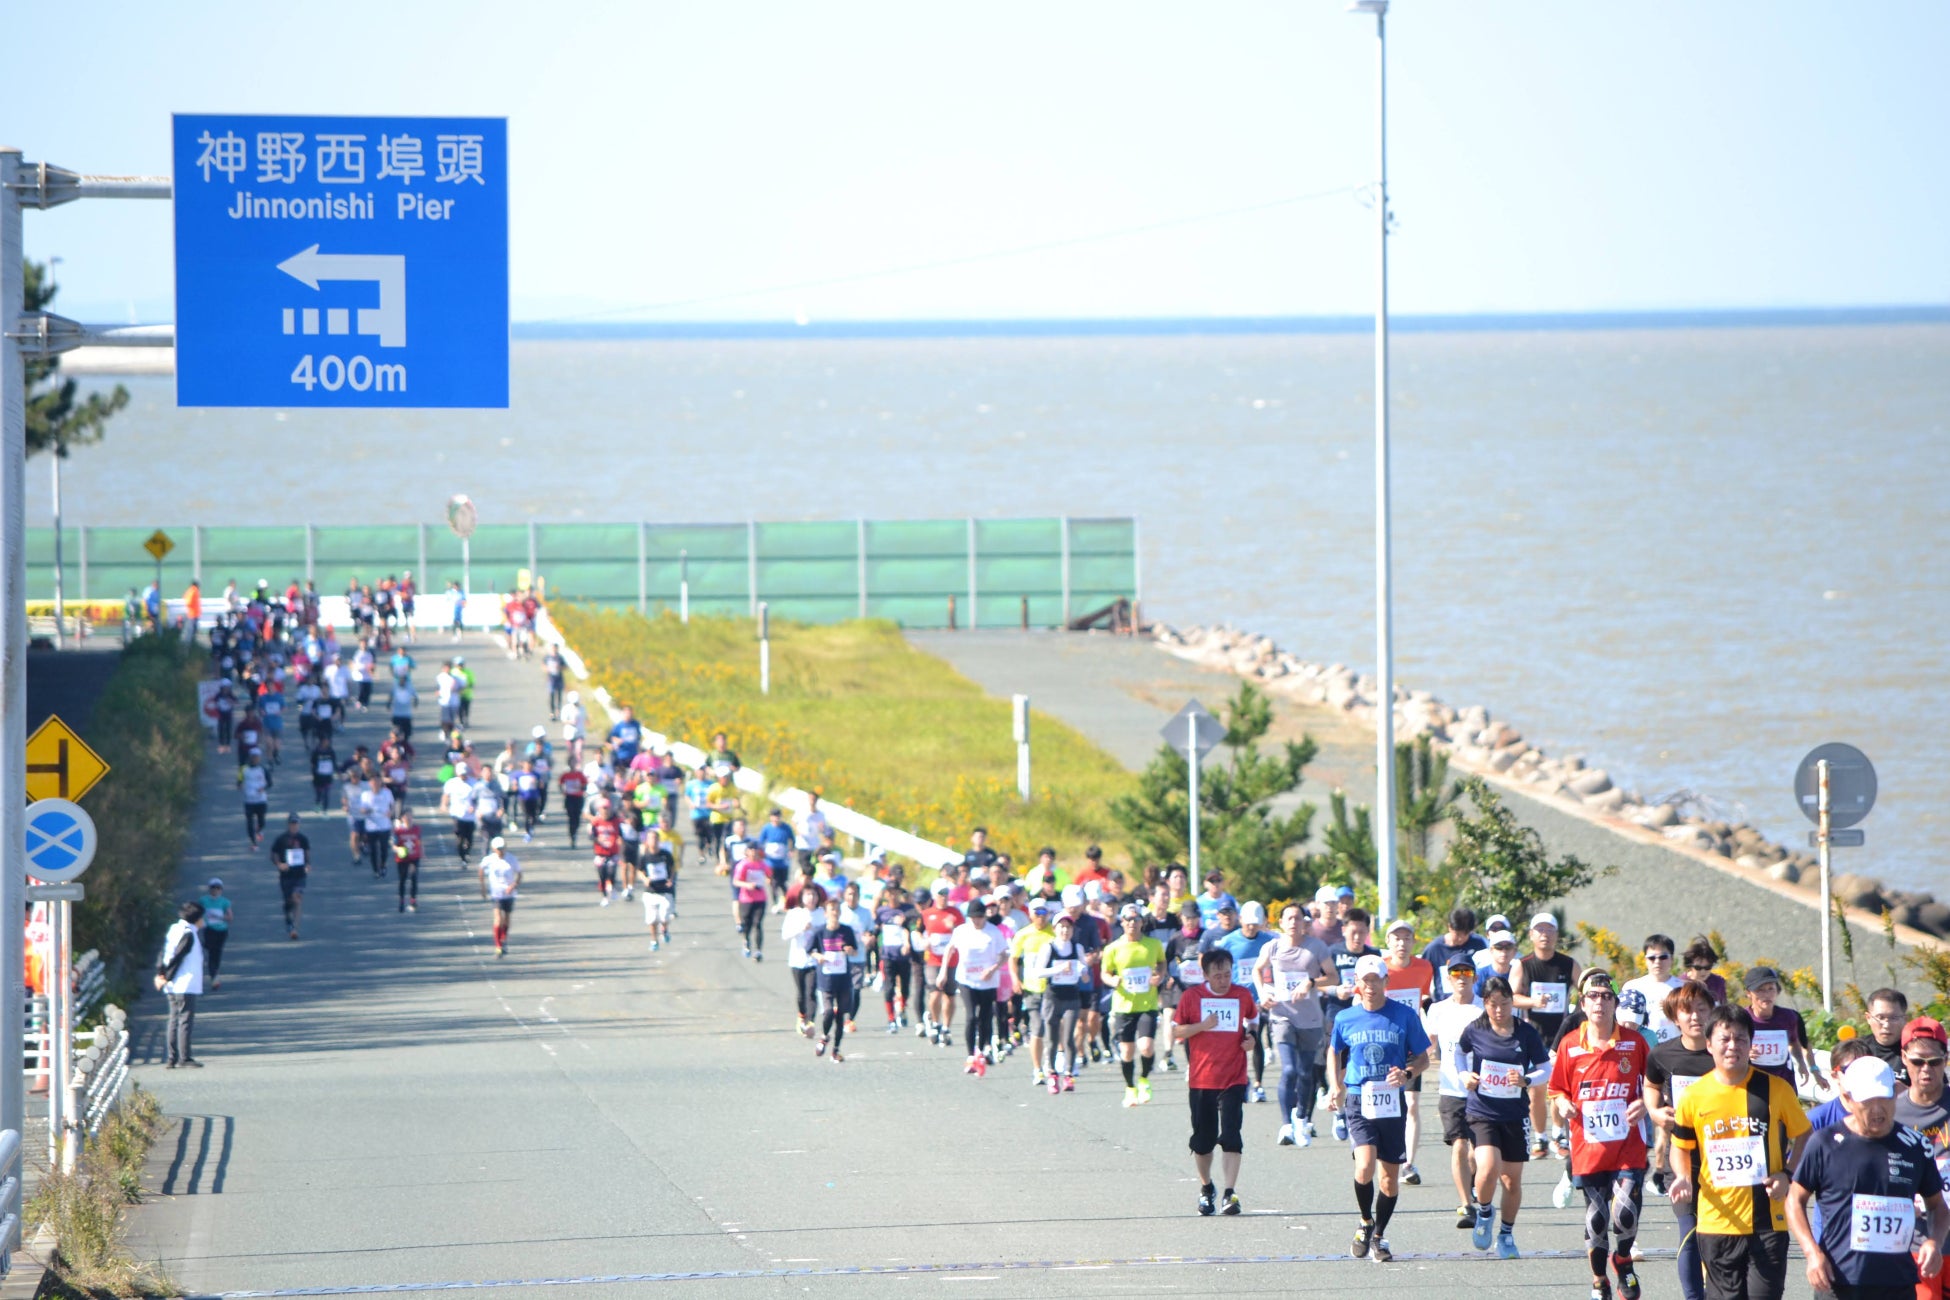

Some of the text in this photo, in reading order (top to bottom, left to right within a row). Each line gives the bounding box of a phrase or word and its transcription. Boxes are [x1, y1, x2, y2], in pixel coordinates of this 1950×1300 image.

[196, 130, 485, 185] 神野西埠頭
[228, 192, 455, 220] Jinnonishi Pier
[291, 355, 407, 392] 400m
[1588, 1113, 1620, 1129] 3170
[1715, 1154, 1753, 1172] 2339
[1860, 1215, 1903, 1235] 3137
